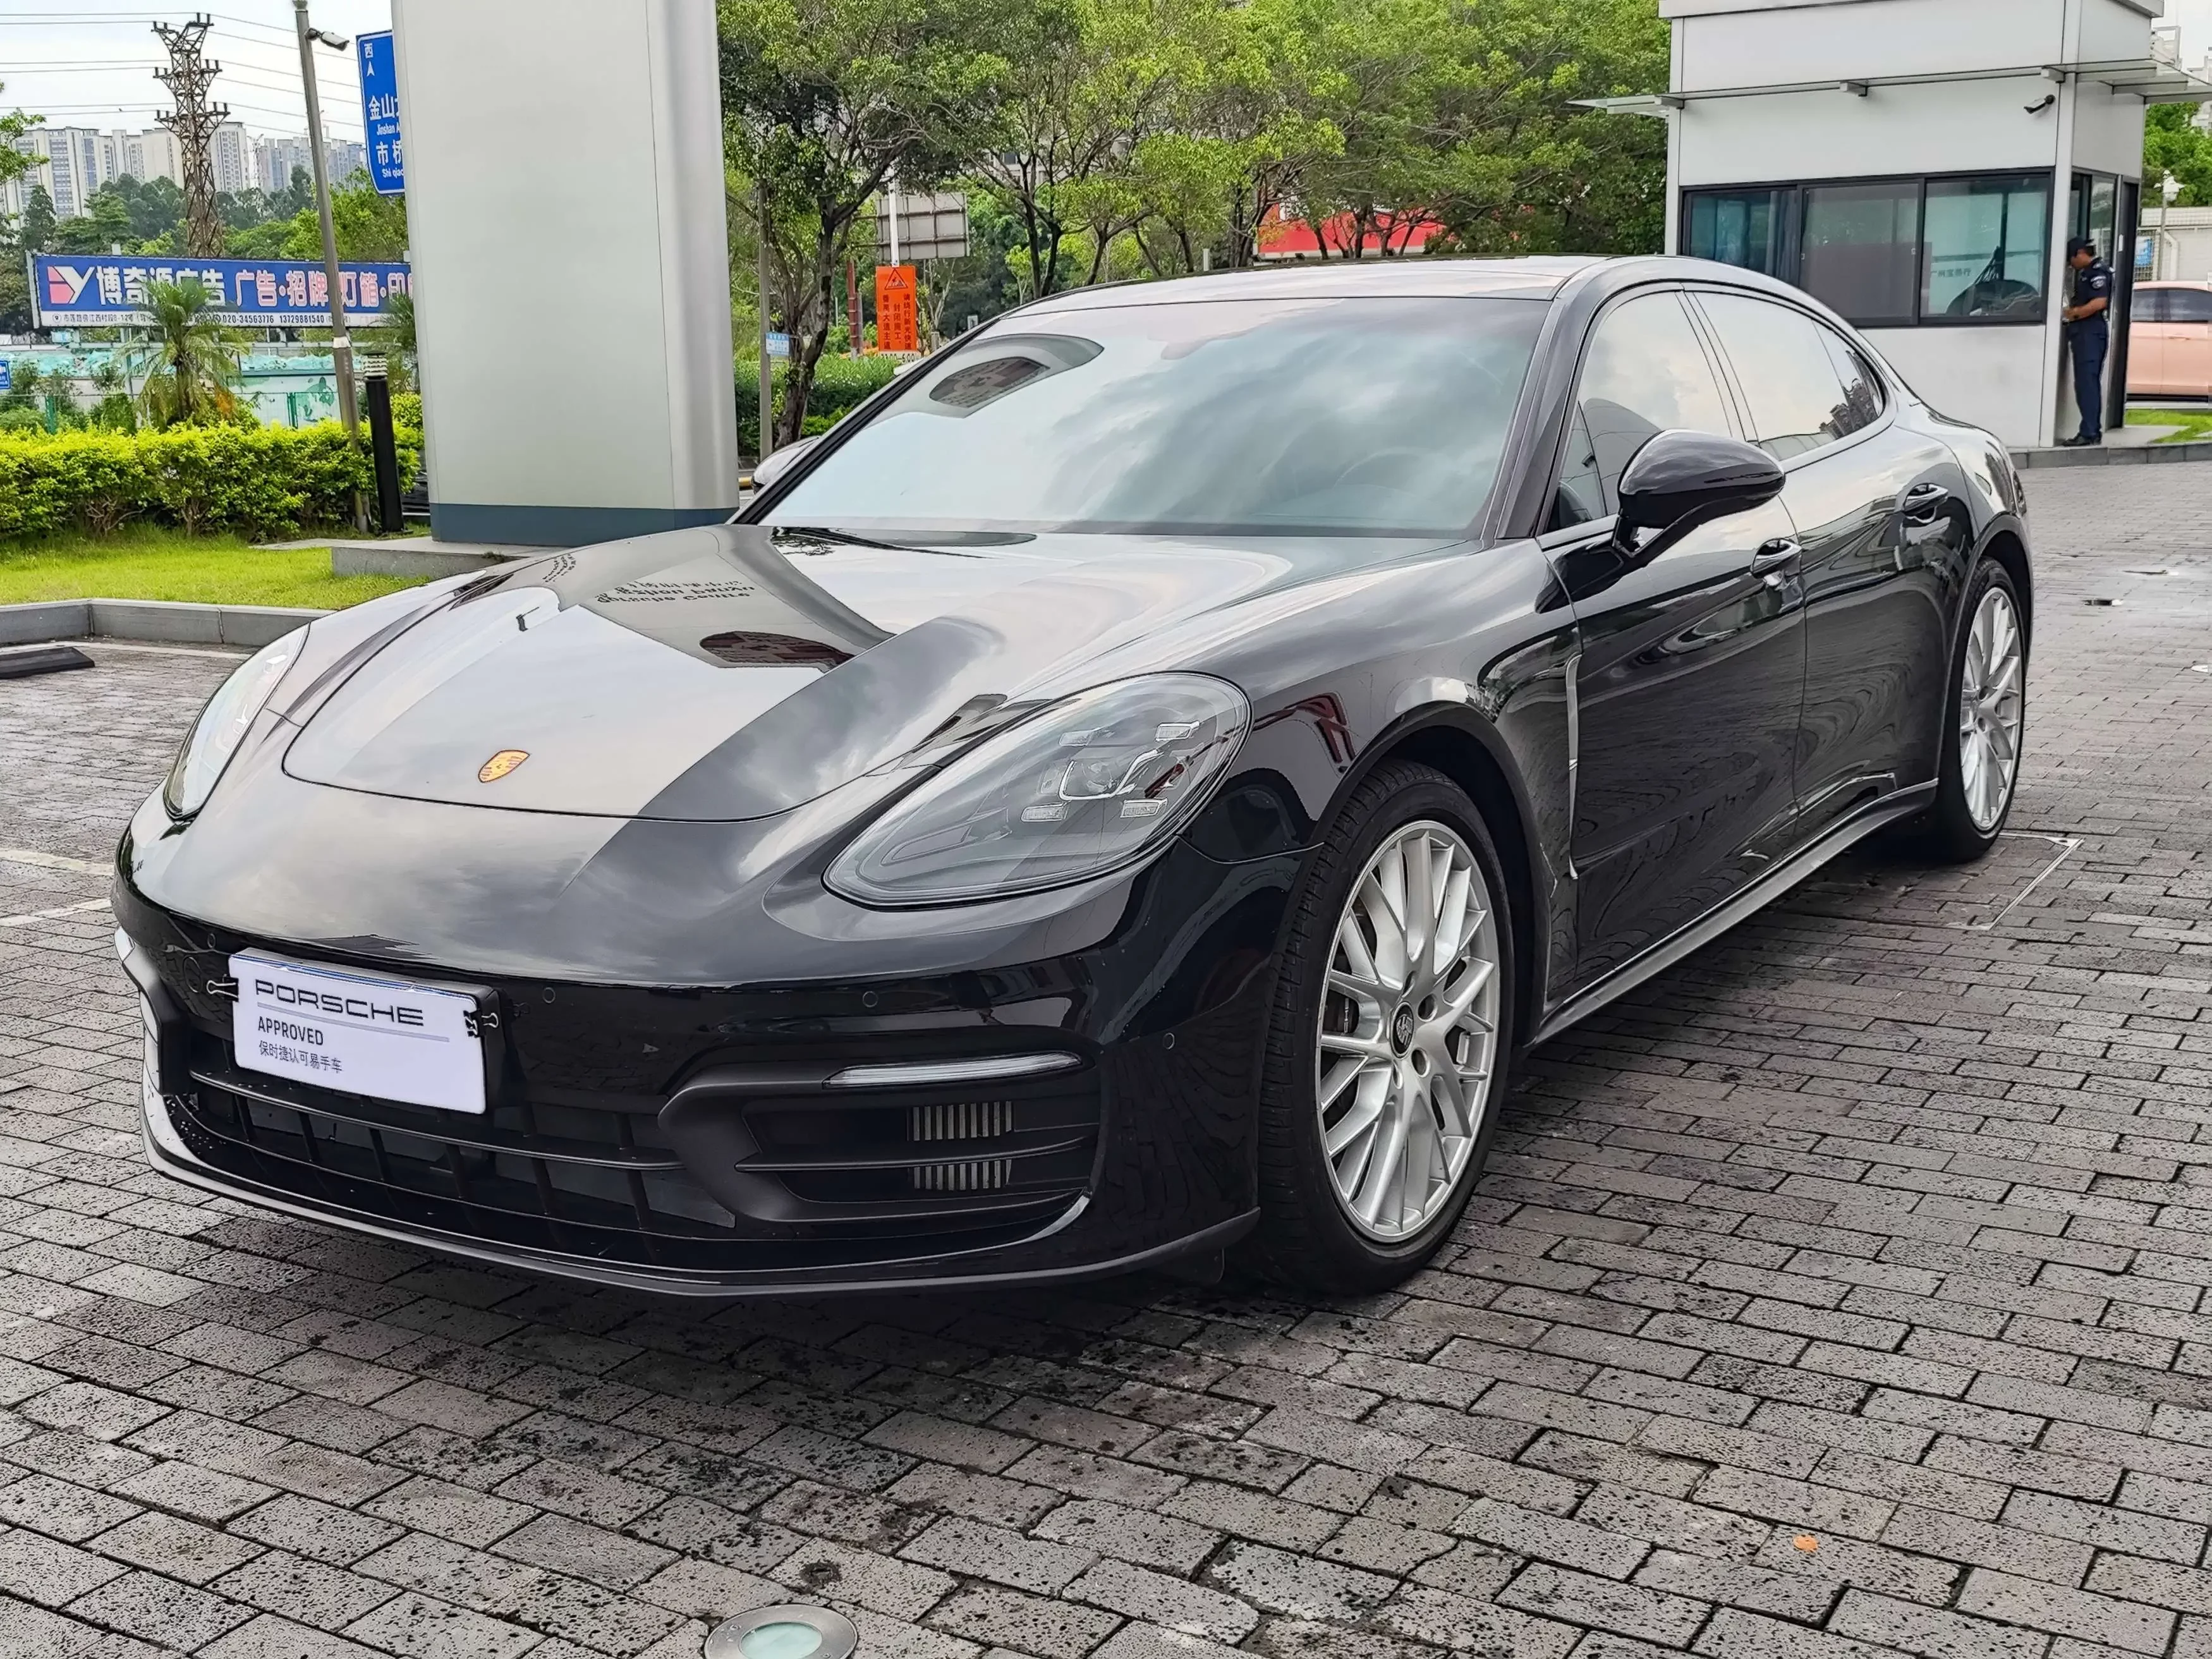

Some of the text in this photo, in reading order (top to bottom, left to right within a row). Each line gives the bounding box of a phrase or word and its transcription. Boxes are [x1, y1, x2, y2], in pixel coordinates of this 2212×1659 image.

[364, 43, 374, 58] 西
[368, 93, 399, 121] 金山
[382, 167, 391, 178] Shi
[222, 315, 274, 324] 020-34563776
[279, 315, 324, 324] 13729881540
[255, 979, 424, 1027] PORSCHE
[258, 1016, 324, 1046] APPROVED
[258, 1040, 343, 1074] 保时捷认可易手车
